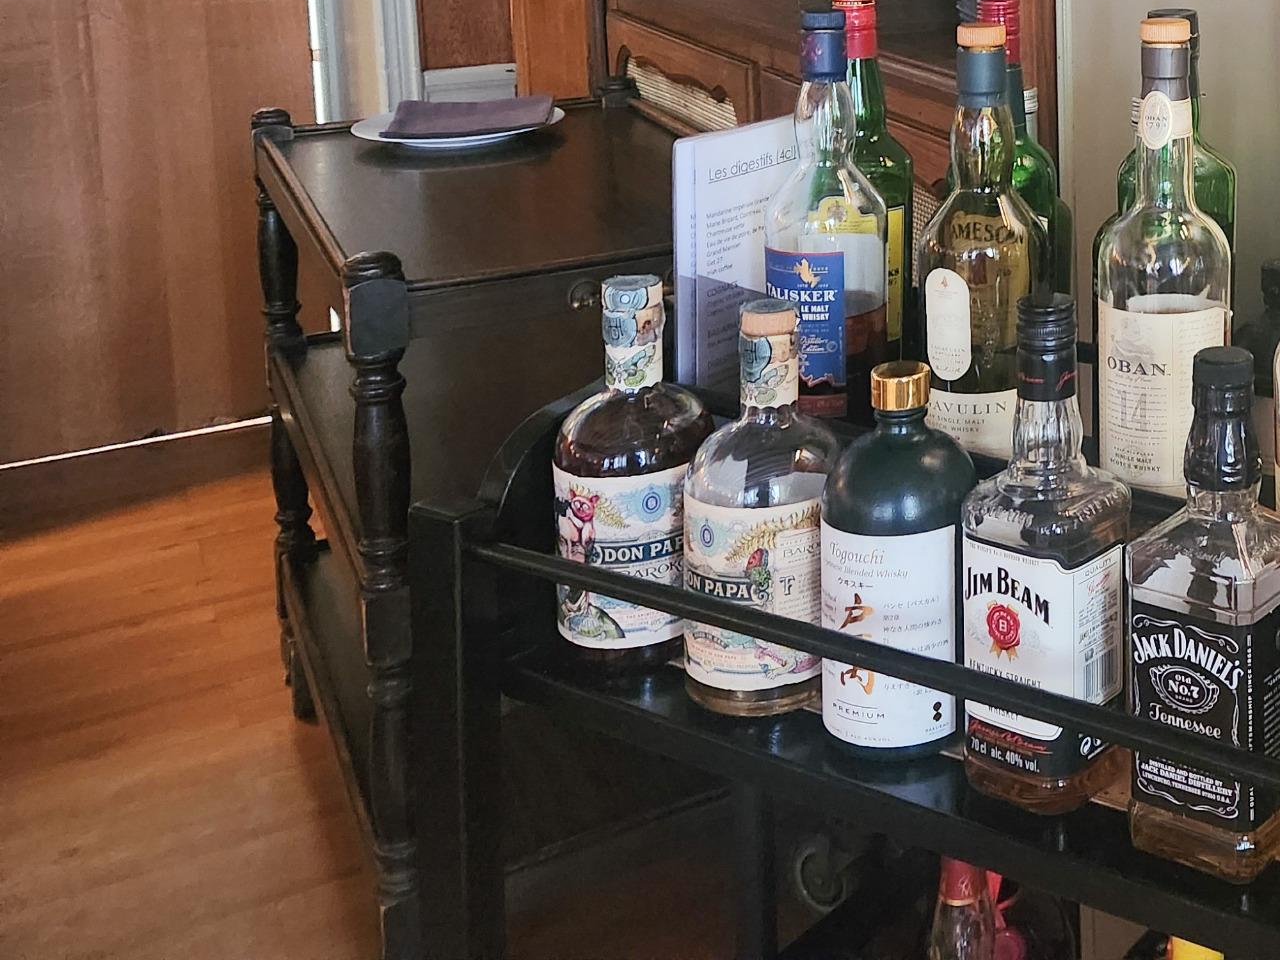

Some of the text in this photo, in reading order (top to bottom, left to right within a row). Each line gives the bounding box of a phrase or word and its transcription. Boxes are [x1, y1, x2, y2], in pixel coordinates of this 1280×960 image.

[709, 152, 773, 181] Les digestifs
[767, 282, 836, 302] TALISKER
[802, 312, 830, 321] WHISKY
[811, 304, 829, 312] MALT
[951, 425, 980, 434] WHISKY
[605, 542, 644, 562] DON
[829, 542, 885, 565] Togouchi
[876, 567, 909, 581] Whisky
[1085, 556, 1113, 578] QUALITY
[704, 578, 746, 599] PAPA
[965, 566, 993, 601] JIM
[997, 567, 1050, 626] BEAM
[1132, 628, 1244, 690] JACK DANIEL'S
[832, 701, 886, 720] PREMIUM
[1149, 702, 1221, 739] Tennessee
[990, 745, 1041, 774] alc. 40% vol.
[1141, 763, 1233, 797] JACK DANIEL DISTILLERY
